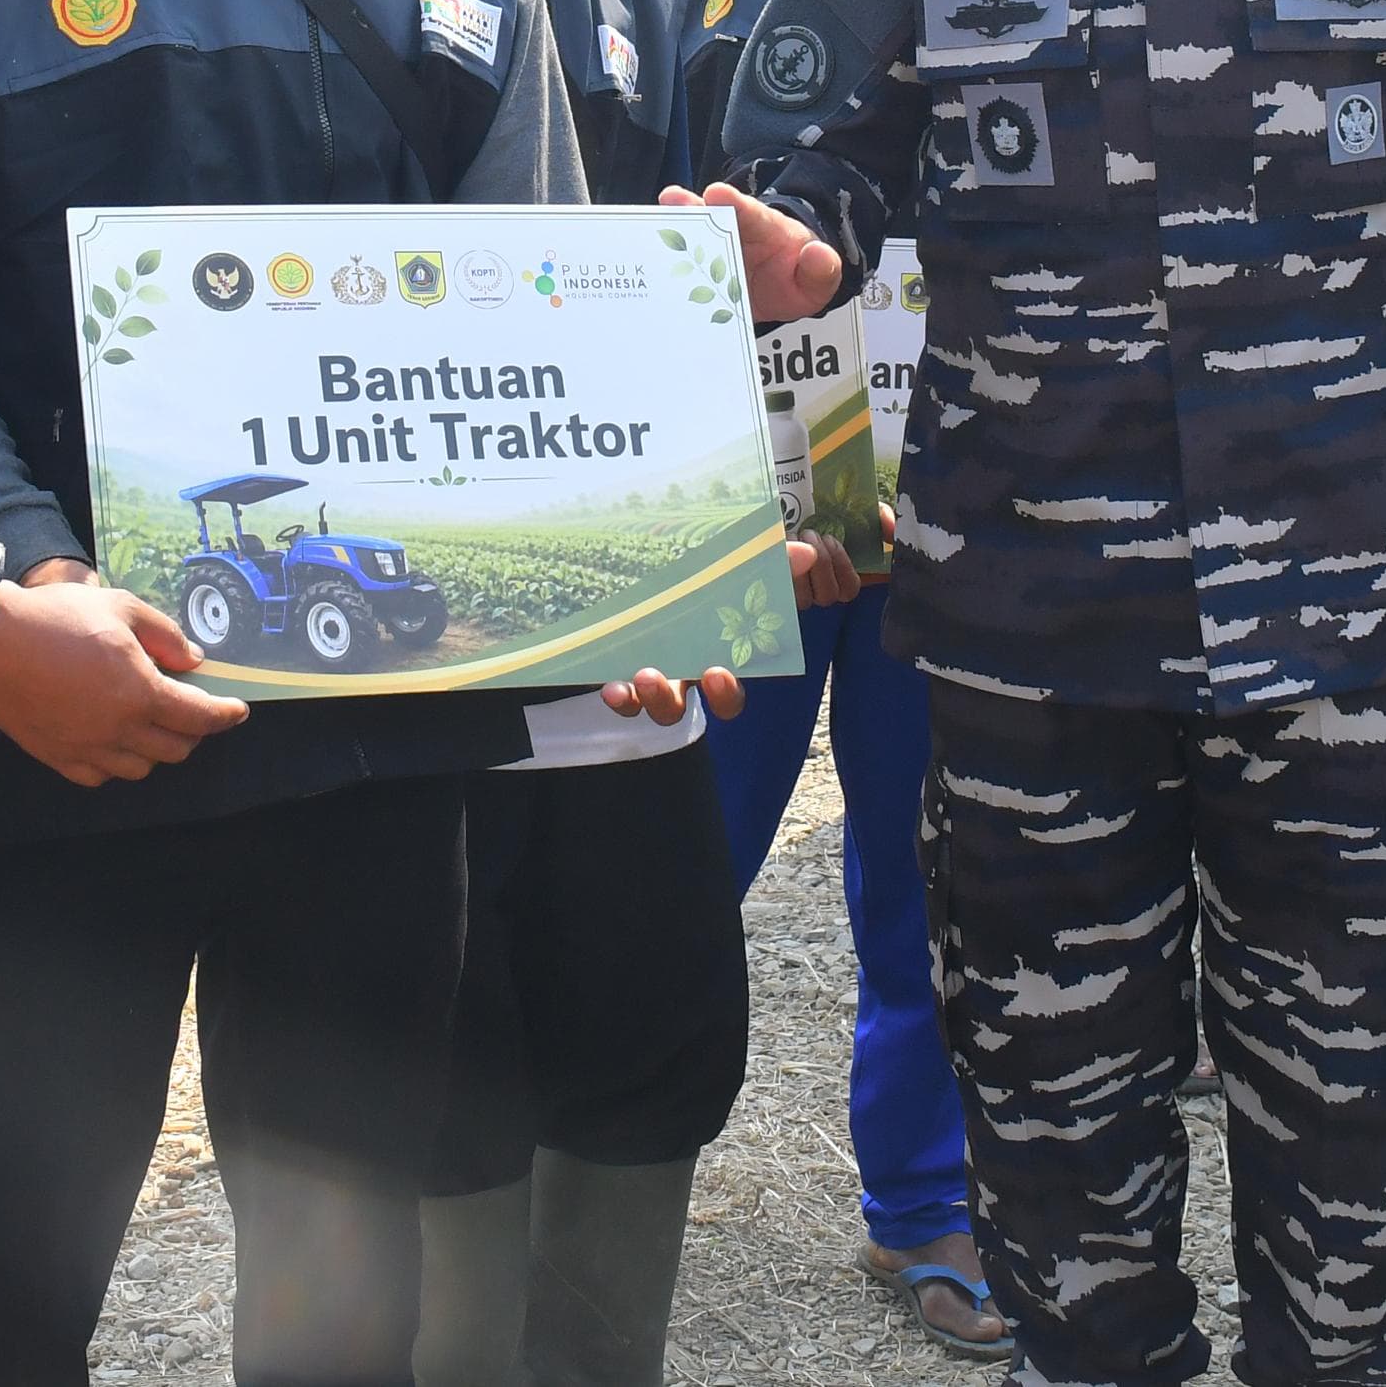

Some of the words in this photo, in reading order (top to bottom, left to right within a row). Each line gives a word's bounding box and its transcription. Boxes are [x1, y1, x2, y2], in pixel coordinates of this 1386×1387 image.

[471, 269, 496, 278] KOPTI
[561, 264, 646, 276] PUPUK
[564, 278, 648, 289] INDONESIA
[319, 354, 565, 403] Bantuan
[242, 418, 268, 466] 1
[289, 414, 417, 465] Unit
[430, 412, 652, 462] Traktor
